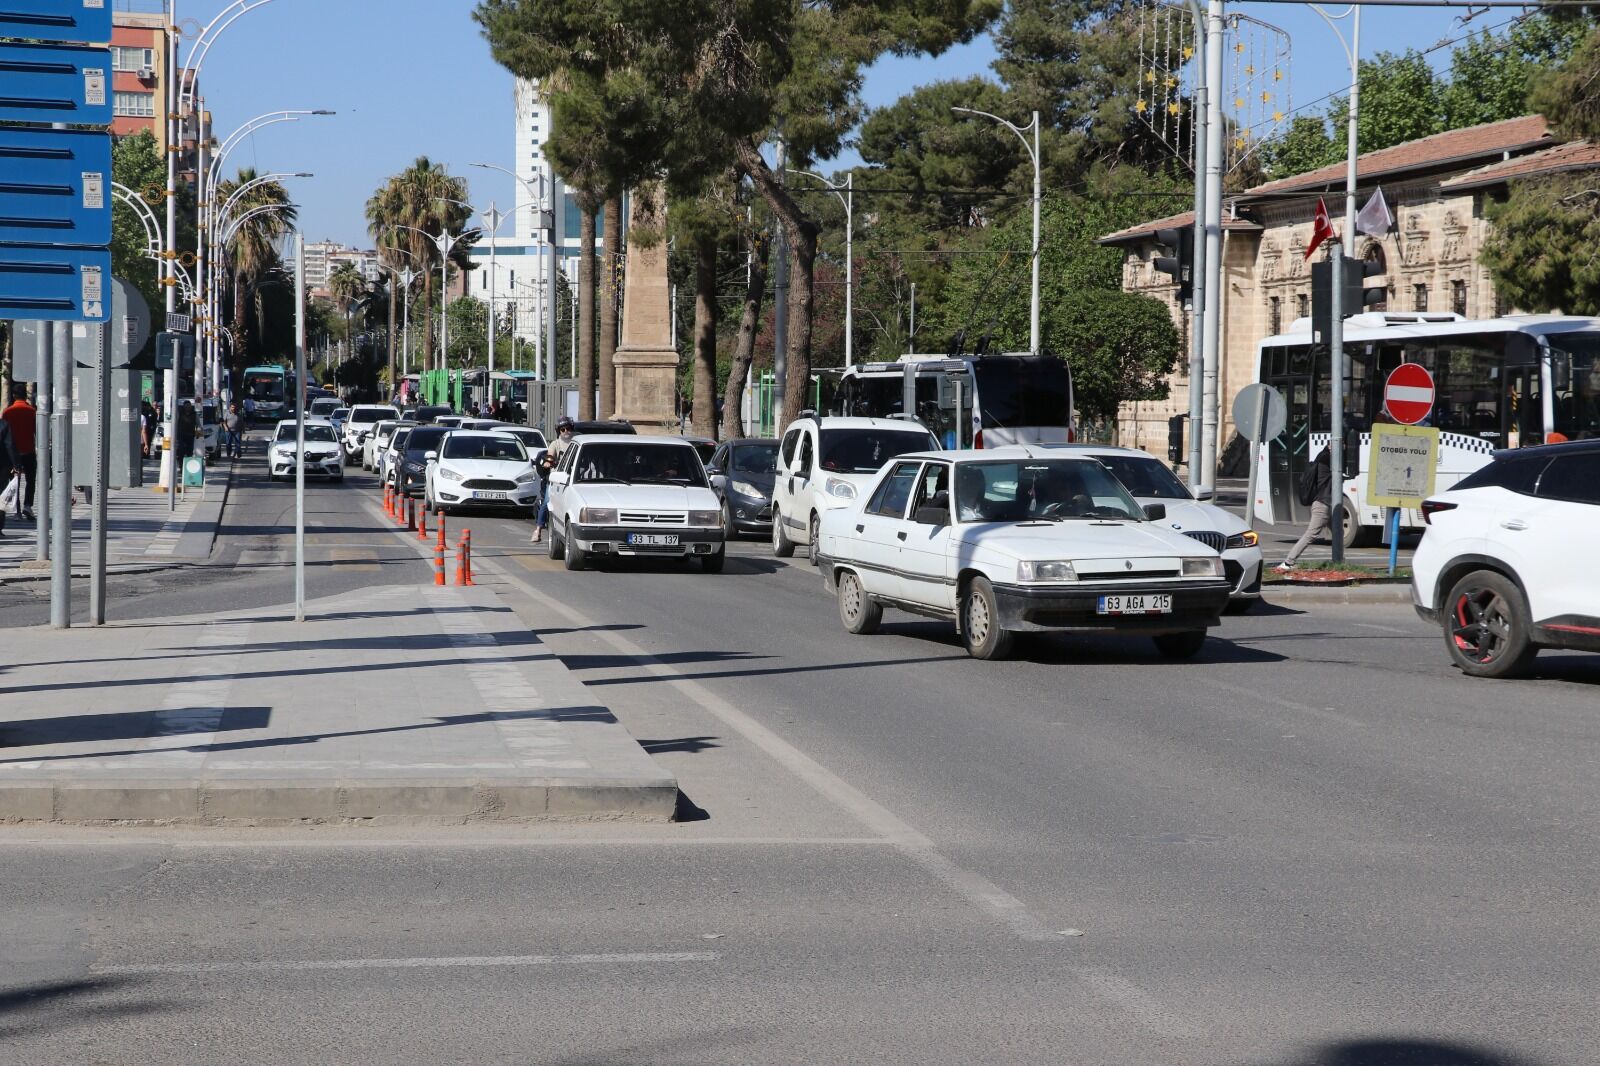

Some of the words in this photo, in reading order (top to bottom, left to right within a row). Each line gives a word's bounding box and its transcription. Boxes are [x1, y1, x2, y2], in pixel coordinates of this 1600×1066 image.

[1381, 446, 1408, 454] OTOBÜS
[632, 535, 643, 544] 33
[647, 535, 659, 544] TL
[664, 535, 678, 545] 137
[1107, 597, 1120, 610] 63
[1126, 596, 1145, 609] AGA
[1152, 595, 1169, 609] 215
